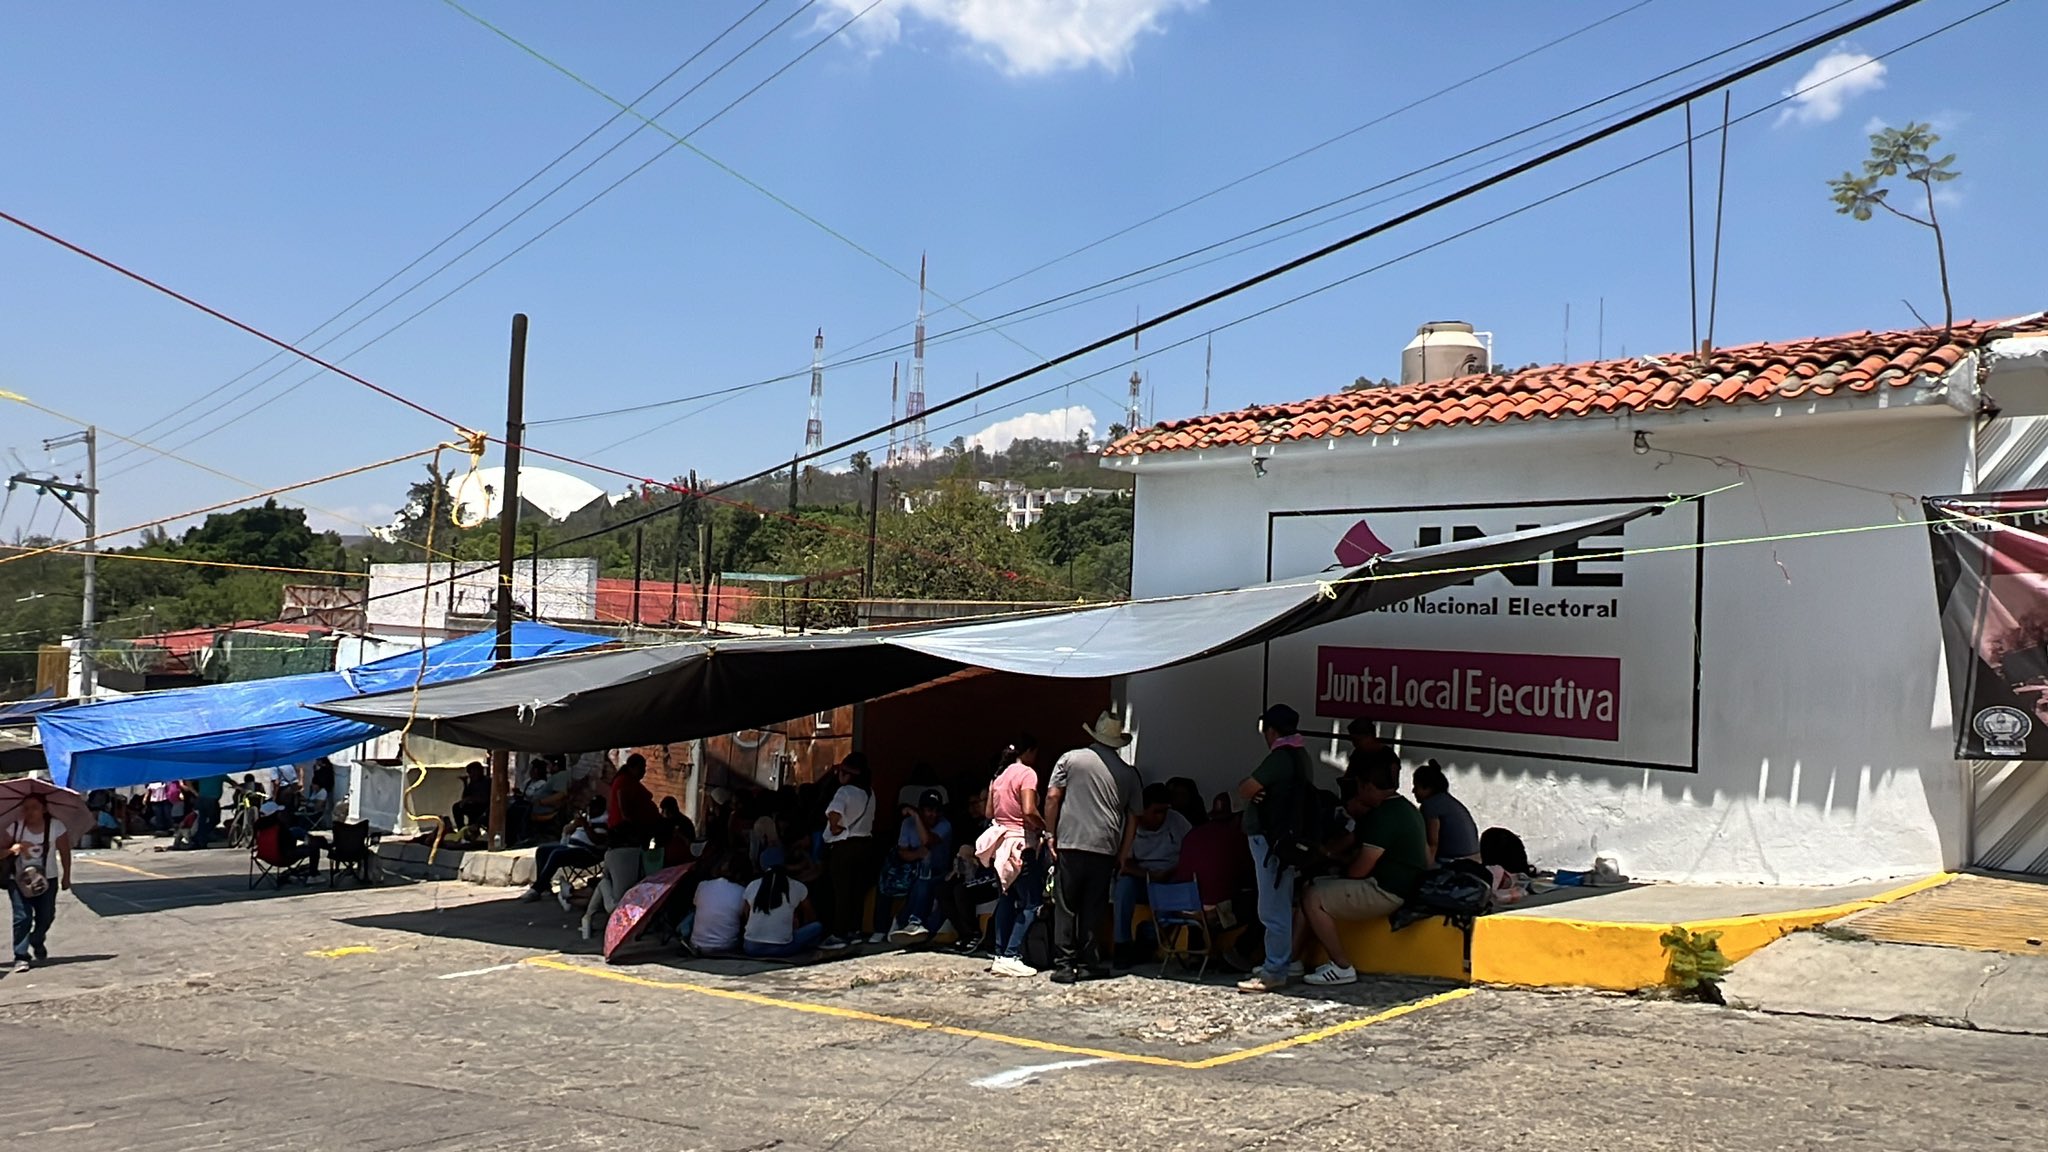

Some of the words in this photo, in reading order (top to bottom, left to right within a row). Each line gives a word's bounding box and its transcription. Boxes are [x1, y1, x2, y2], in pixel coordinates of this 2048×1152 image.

[1414, 596, 1498, 615] Nacional
[1508, 598, 1618, 618] Electoral
[1320, 662, 1386, 705] Junta
[1391, 665, 1459, 710] Local
[1465, 669, 1613, 722] Ejecutiva
